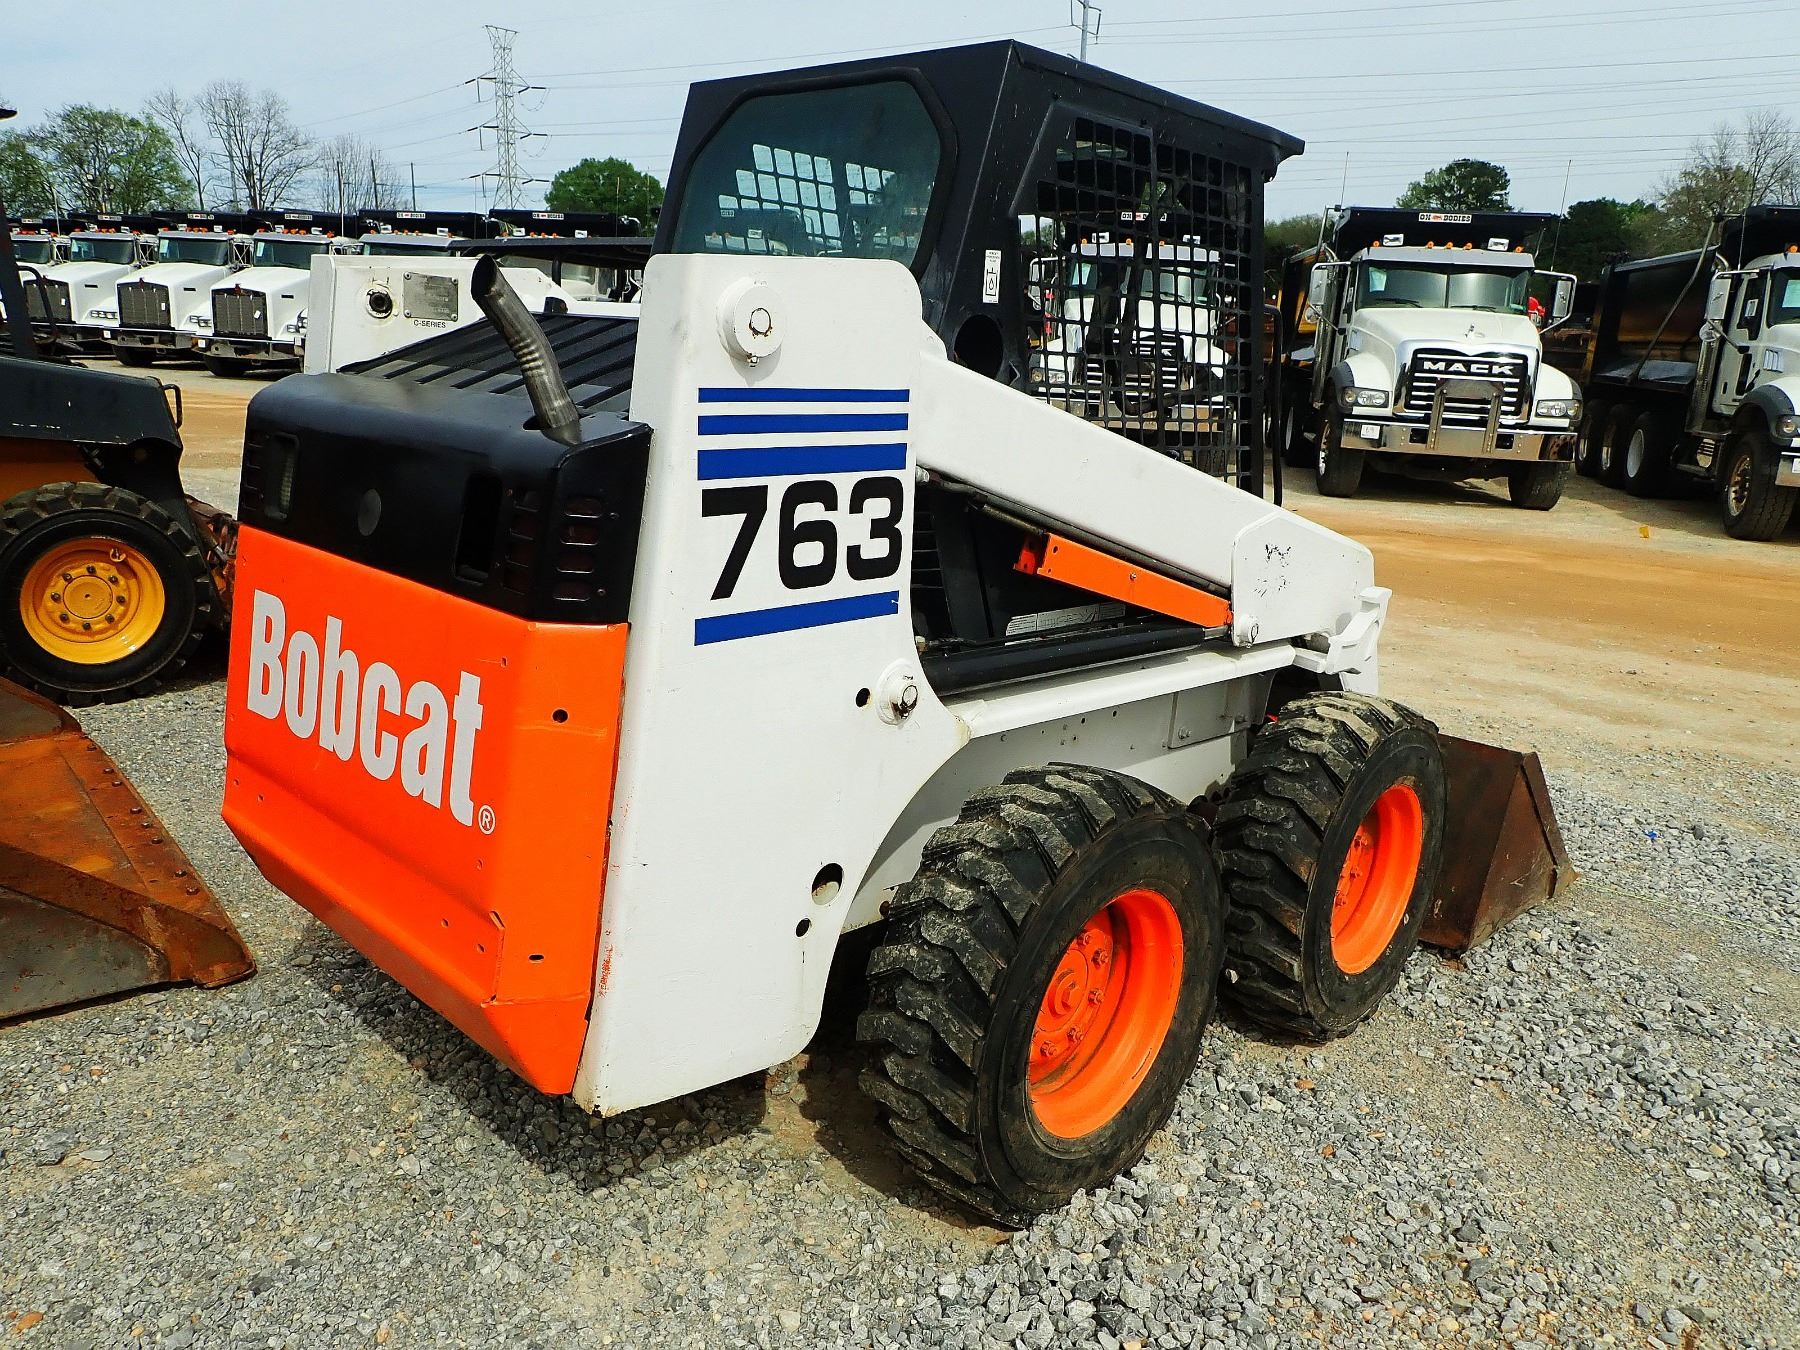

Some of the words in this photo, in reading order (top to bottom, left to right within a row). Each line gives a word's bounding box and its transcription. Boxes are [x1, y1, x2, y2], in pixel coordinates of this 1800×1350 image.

[1443, 214, 1471, 223] BODIES
[413, 319, 447, 329] C-SERIES
[1423, 361, 1515, 376] MACK
[702, 476, 904, 600] 763
[247, 589, 484, 827] Bobcat
